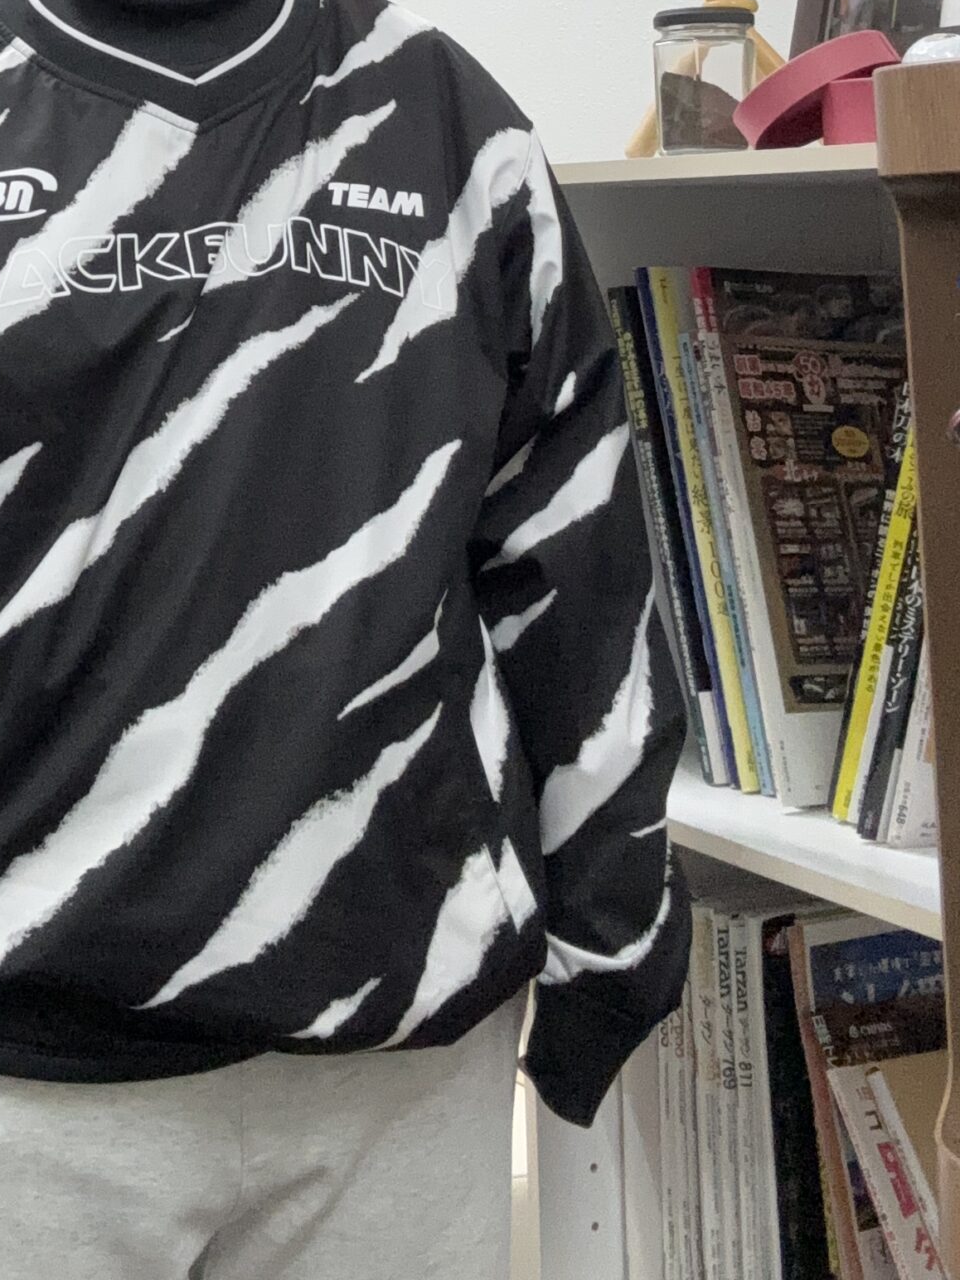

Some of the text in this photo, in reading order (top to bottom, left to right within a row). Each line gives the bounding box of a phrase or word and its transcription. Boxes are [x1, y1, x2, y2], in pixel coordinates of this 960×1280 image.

[328, 182, 424, 218] TEAM
[717, 926, 732, 998] Tarzan
[735, 946, 749, 1012] Tarzan
